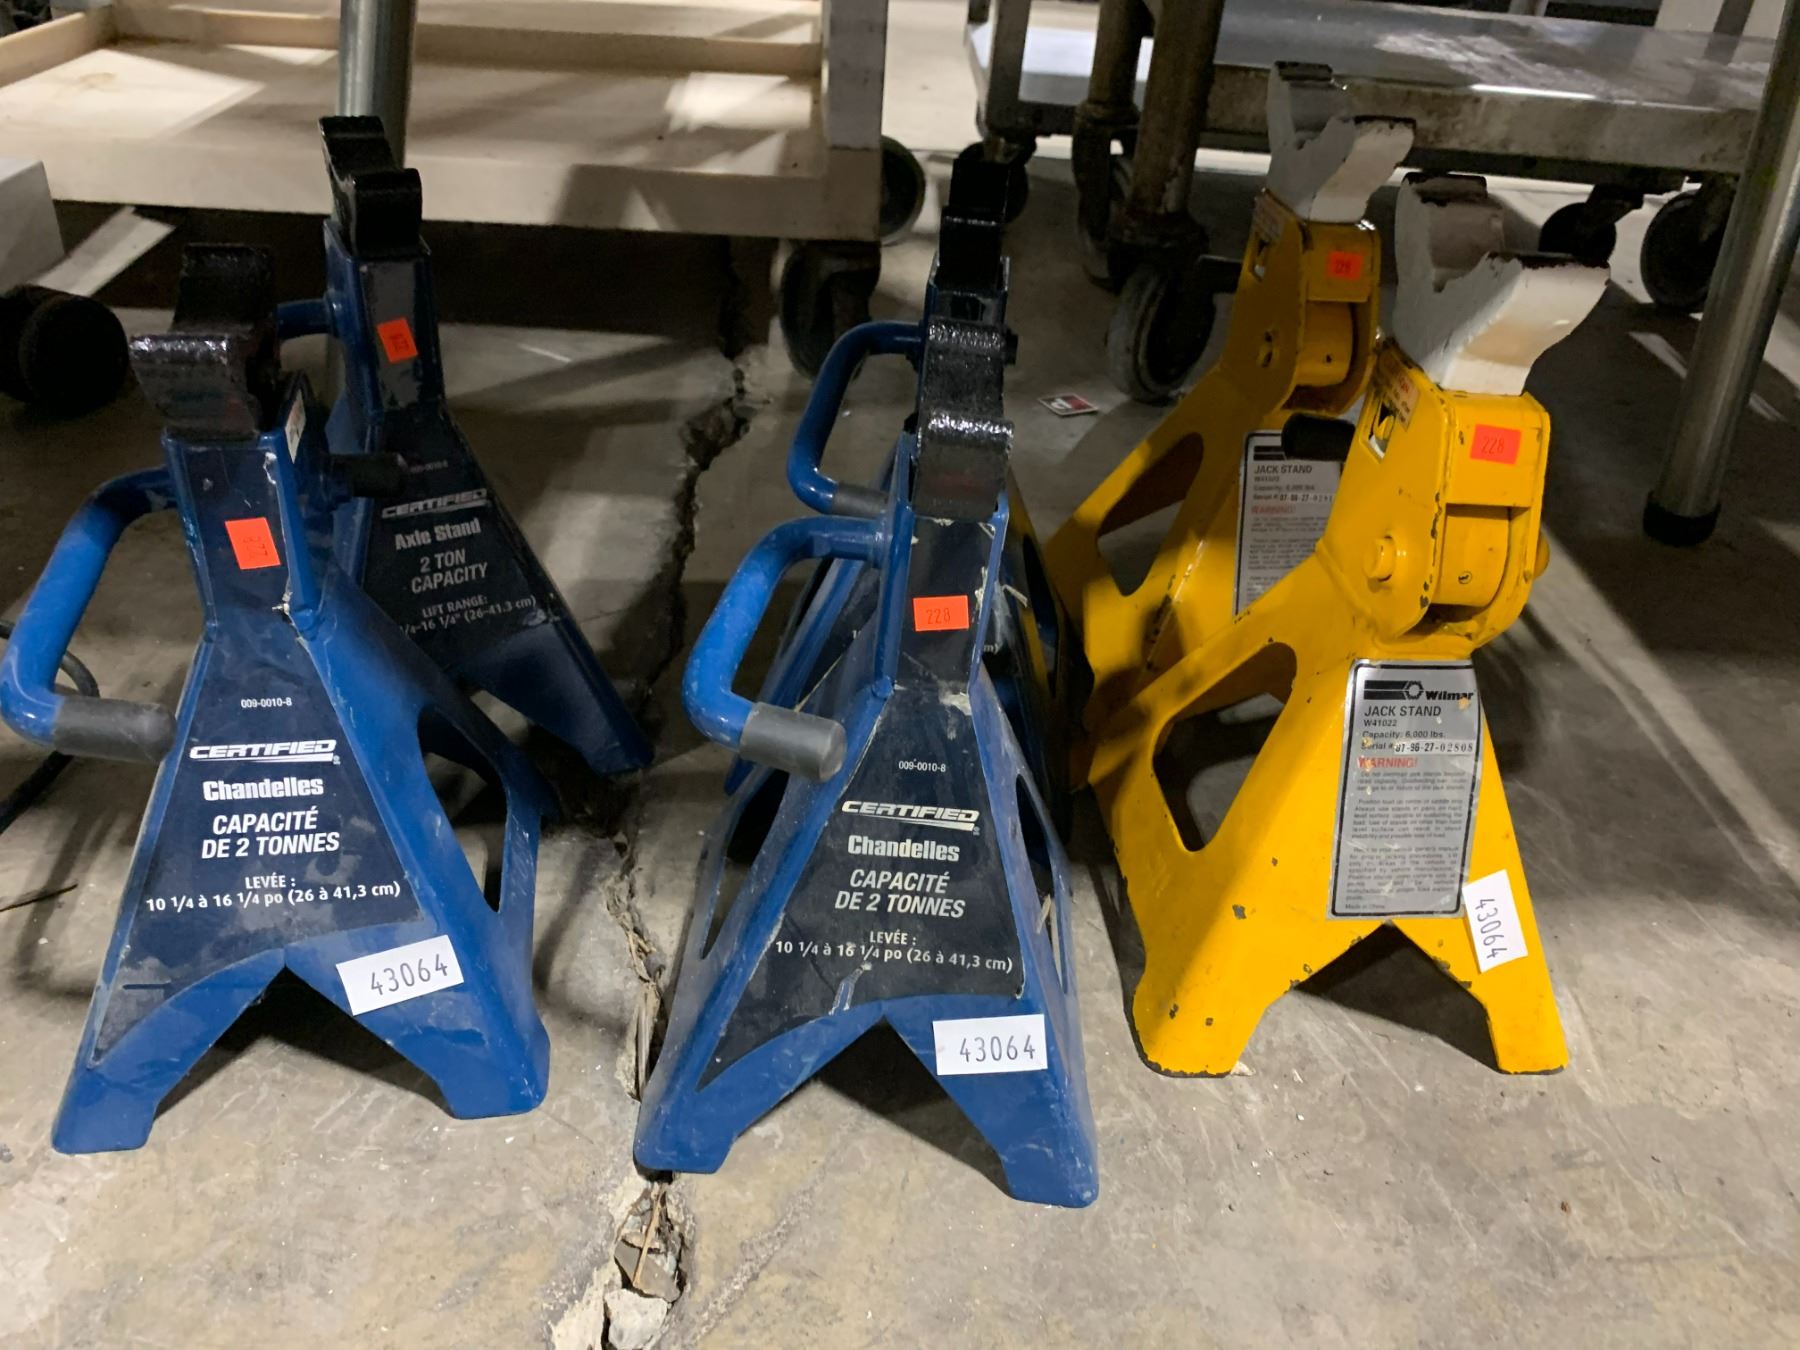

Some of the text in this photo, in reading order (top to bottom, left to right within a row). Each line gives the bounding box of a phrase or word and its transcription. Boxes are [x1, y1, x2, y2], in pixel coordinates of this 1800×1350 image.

[1254, 465, 1312, 474] JACK STAND
[382, 488, 487, 518] CERTIFIED
[395, 517, 481, 550] Axle Stand
[420, 548, 466, 573] 2 TON
[411, 562, 488, 594] CAPACITY
[422, 604, 444, 619] LIFT
[241, 697, 292, 708] 009-0010-8
[1425, 690, 1474, 701] Wilmar
[1364, 705, 1442, 717] JACK STAND
[190, 739, 337, 760] CERTIFIED
[898, 760, 947, 773] 009-0010-8
[1358, 756, 1418, 769] WARNING!
[203, 776, 324, 801] Chandelles
[212, 806, 319, 835] CAPACITÉ
[841, 800, 980, 823] CERTIFIED
[201, 832, 340, 860] DE 2 TONNES
[848, 834, 960, 862] Chandelles
[245, 872, 287, 889] LEVÉE
[850, 869, 950, 894] CAPACITÉ
[146, 881, 400, 913] 10 1/4 à 16 1/4 po (26 à 41,3 cm)
[835, 891, 966, 918] DE 2 TONNES
[869, 929, 908, 945] LEVÉE
[1475, 899, 1507, 959] 43064
[776, 940, 1013, 974] 10 1/4 à 16 1/4 po (26 à 41,3 cm)
[370, 953, 449, 997] 43064
[959, 1034, 1036, 1063] 43064
